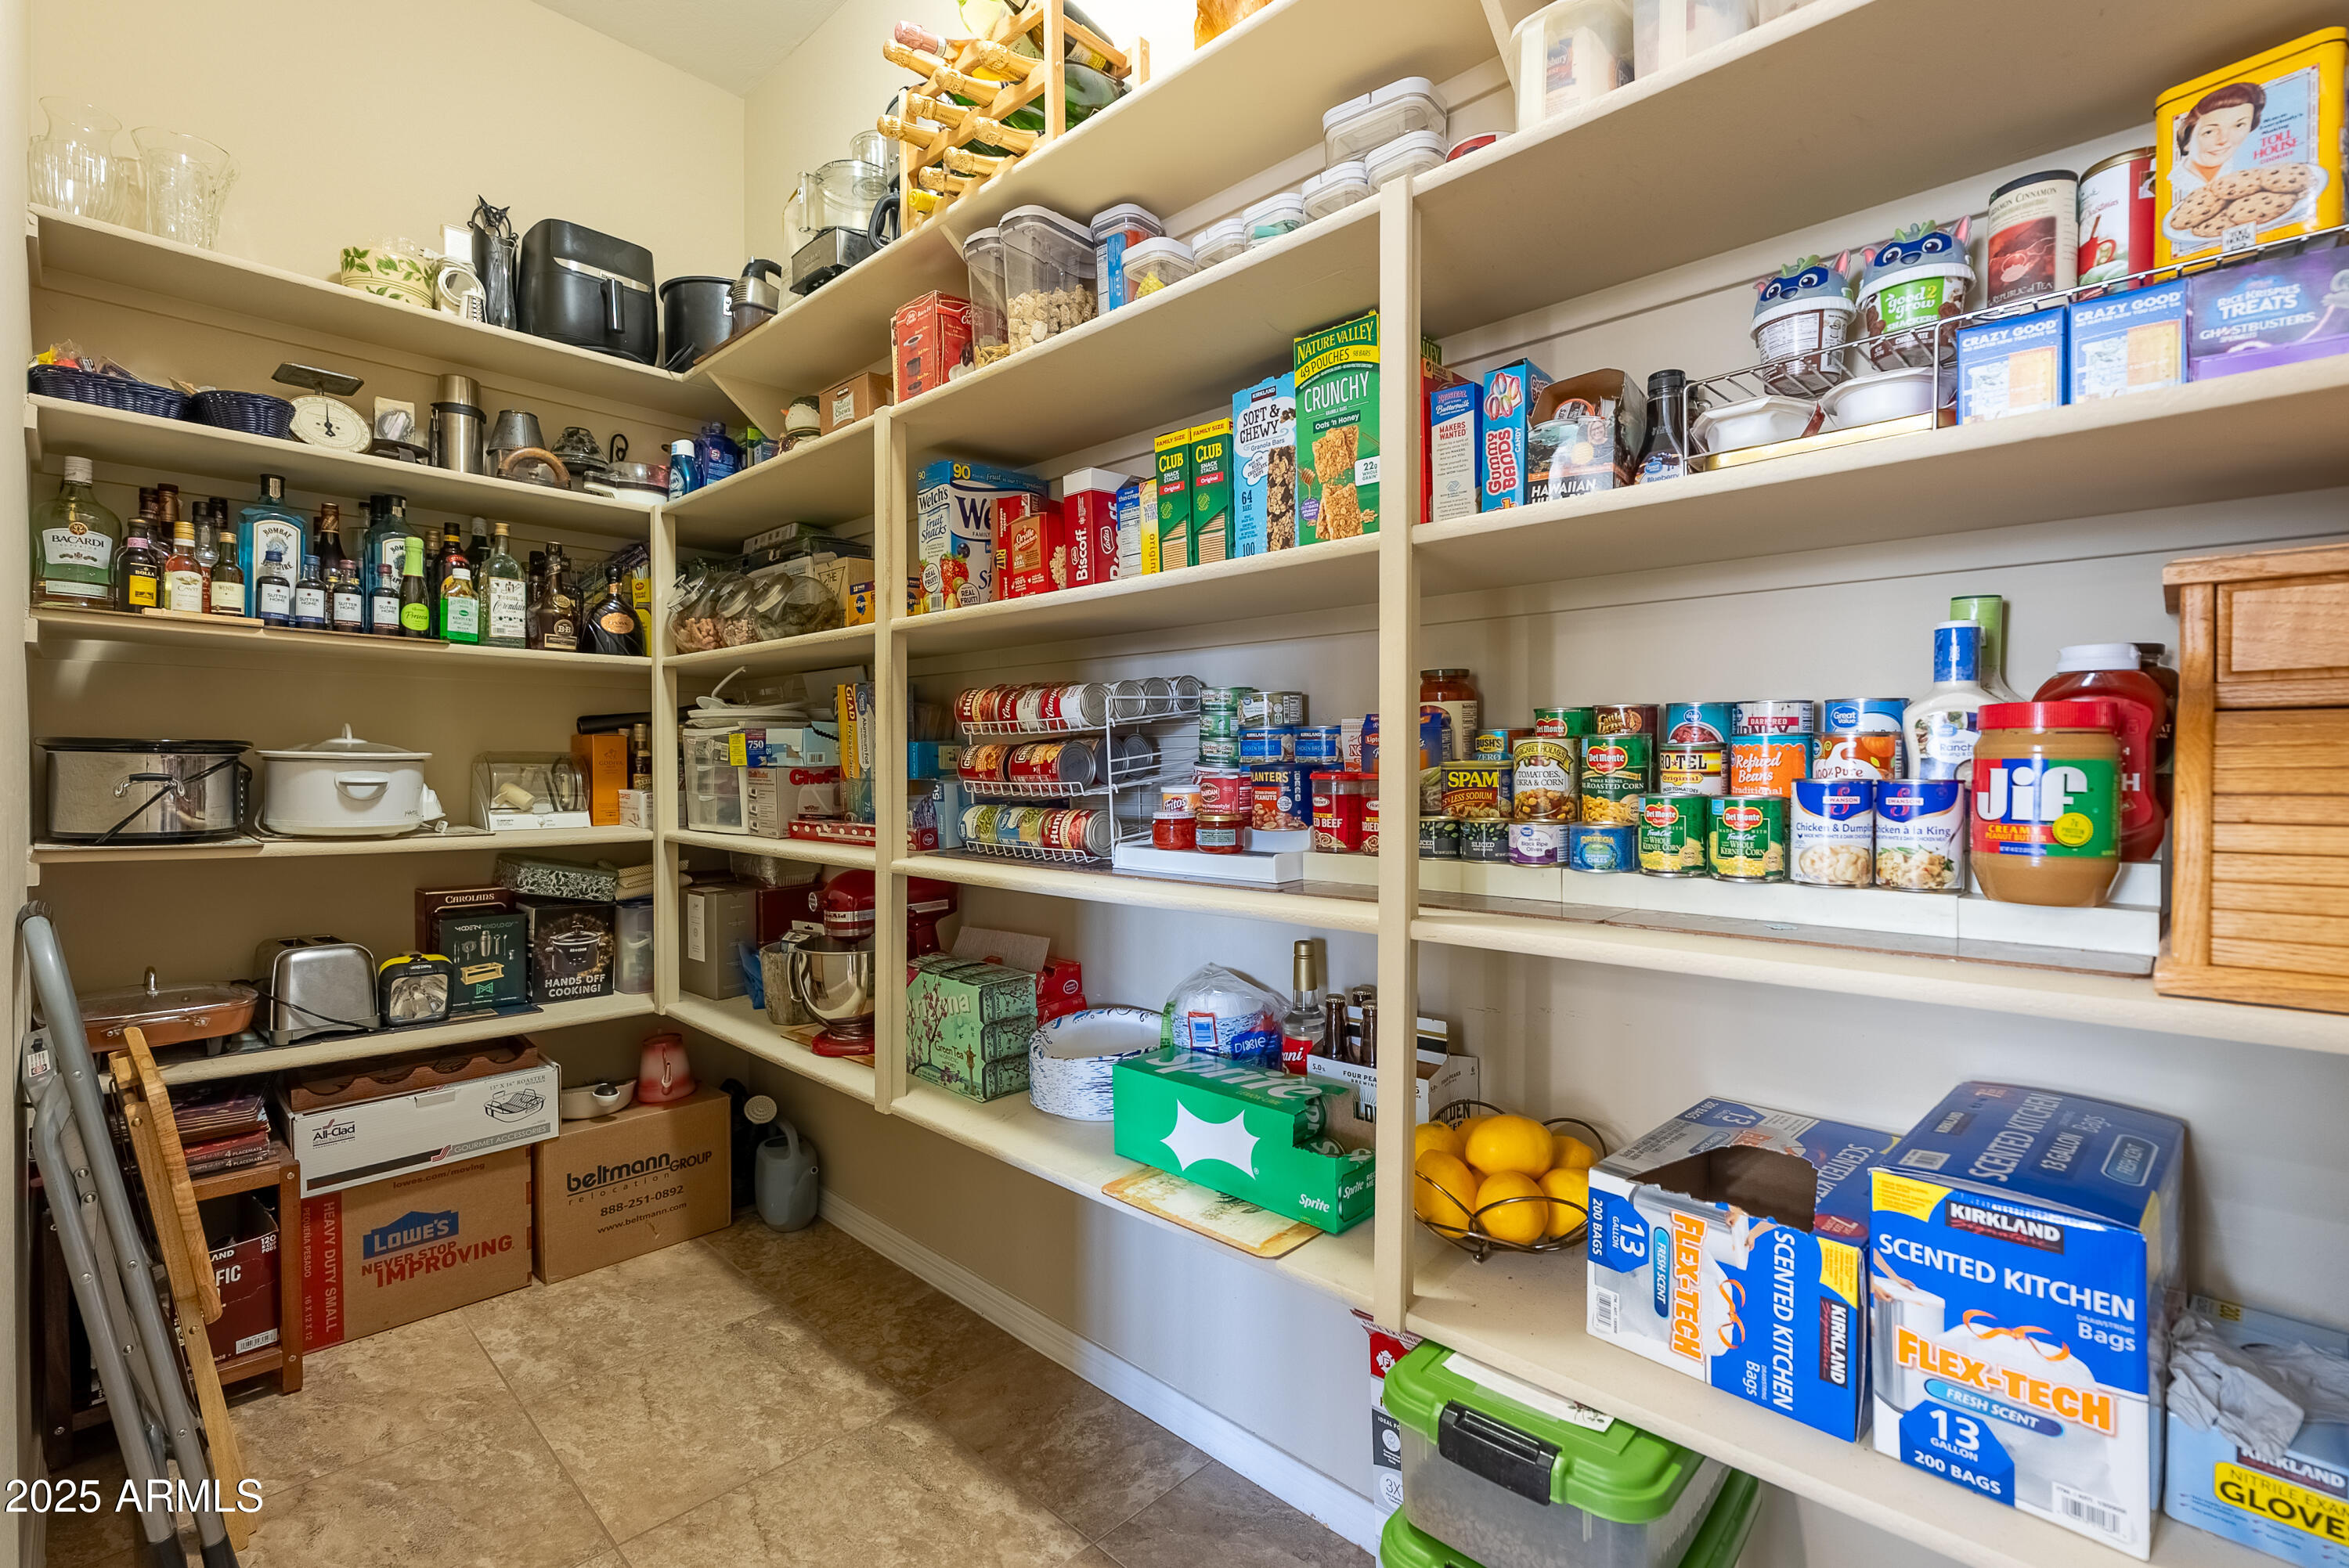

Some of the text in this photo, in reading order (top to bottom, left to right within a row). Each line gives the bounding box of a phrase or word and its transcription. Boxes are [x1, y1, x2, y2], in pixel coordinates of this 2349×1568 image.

[1927, 286, 1937, 298] 2
[2217, 294, 2244, 308] RICE
[2246, 283, 2300, 300] KRISPIES
[2075, 291, 2179, 322] CRAZY GOOD
[2219, 294, 2297, 320] TREATS
[1297, 321, 1373, 364] NATURE VALLEY
[1962, 320, 2055, 348] CRAZY GOOD
[1304, 371, 1369, 413] CRUNCHY
[1243, 404, 1280, 427] SOFT &
[1436, 401, 1470, 415] Buttermilk
[1240, 419, 1279, 443] CHEWY
[1440, 422, 1466, 433] MAKERS
[1440, 429, 1467, 440] WANTED
[1159, 452, 1183, 472] CLUB
[1196, 442, 1222, 463] CLUB
[918, 470, 926, 481] 90
[953, 463, 971, 480] 90
[1201, 475, 1218, 484] Original
[918, 487, 948, 510] Welch's
[1164, 484, 1180, 492] Original
[1242, 489, 1252, 505] 64
[1532, 478, 1597, 499] HAWAIIAN
[926, 514, 943, 531] Fruit
[52, 535, 104, 548] BACARDI
[263, 528, 293, 539] BOMBAY
[921, 524, 947, 543] Snacks
[1102, 529, 1113, 550] Lotus
[996, 549, 1006, 570] RITZ
[1243, 542, 1254, 557] 100
[845, 686, 855, 720] GLAD
[1834, 712, 1856, 720] Great
[748, 741, 763, 749] 750
[1476, 737, 1503, 749] BUSH'S
[1515, 745, 1565, 759] MARGARET HOLMES
[1600, 753, 1625, 762] Monte
[1736, 752, 1781, 770] Refried
[1448, 771, 1499, 788] SPAM
[1738, 770, 1773, 783] Beans
[1835, 767, 1863, 778] Pure
[1451, 791, 1492, 803] LESS SODIUM
[1732, 785, 1783, 795] Traditional
[1977, 766, 2088, 821] Jif
[1322, 818, 1344, 827] BEEF
[445, 893, 495, 904] CAROLANS
[545, 974, 606, 988] HANDS OFF
[549, 984, 601, 998] COOKING!
[934, 1040, 964, 1059] Green Tea
[1146, 1053, 1322, 1098] Sprite
[1343, 1070, 1362, 1079] FOUR
[313, 1124, 355, 1141] All-Clad
[454, 1125, 546, 1153] GOURMET ACCESSORIES
[1968, 1093, 2063, 1182] SCENTED KITCHEN
[226, 1146, 262, 1158] 4 PLACEMATS
[1822, 1144, 1875, 1181] SCENTED
[2040, 1132, 2084, 1172] 13 GALLON
[393, 1162, 485, 1188] lowes.com/moving
[567, 1151, 713, 1191] beltmann GROUP
[1343, 1179, 1364, 1199] Sprite
[600, 1185, 684, 1217] 888-251-0892
[1299, 1194, 1330, 1213] Sprite
[597, 1202, 687, 1234] www.beltmann.com
[1592, 1199, 1603, 1256] 200 BAGS
[1950, 1203, 2061, 1242] KIRKLAND
[260, 1235, 276, 1245] 120
[374, 1218, 449, 1251] LOWE'S
[1620, 1223, 1644, 1257] 13
[324, 1202, 337, 1332] HEAVY DUTY SMALL
[362, 1240, 456, 1276] NEVER STOP
[1657, 1242, 1666, 1303] FRESH SCENT
[1879, 1234, 1995, 1285] SCENTED
[2004, 1267, 2135, 1321] KITCHEN
[1671, 1211, 1707, 1364] FLEX-TECH
[305, 1312, 312, 1321] 12
[1773, 1231, 1795, 1411] SCENTED KITCHEN
[305, 1331, 312, 1340] 12
[1830, 1304, 1846, 1384] KIRKLAND
[2077, 1325, 2136, 1353] Bags
[1744, 1360, 1760, 1397] Bags
[1896, 1328, 2113, 1433] FLEX-TECH
[1946, 1389, 2038, 1428] FRESH SCENT
[1930, 1409, 1981, 1451] 13
[1930, 1437, 1978, 1462] GALLON
[1914, 1450, 2001, 1495] 200 BAGS
[2230, 1469, 2300, 1501] NITRILE
[2220, 1481, 2349, 1540] GLOVE
